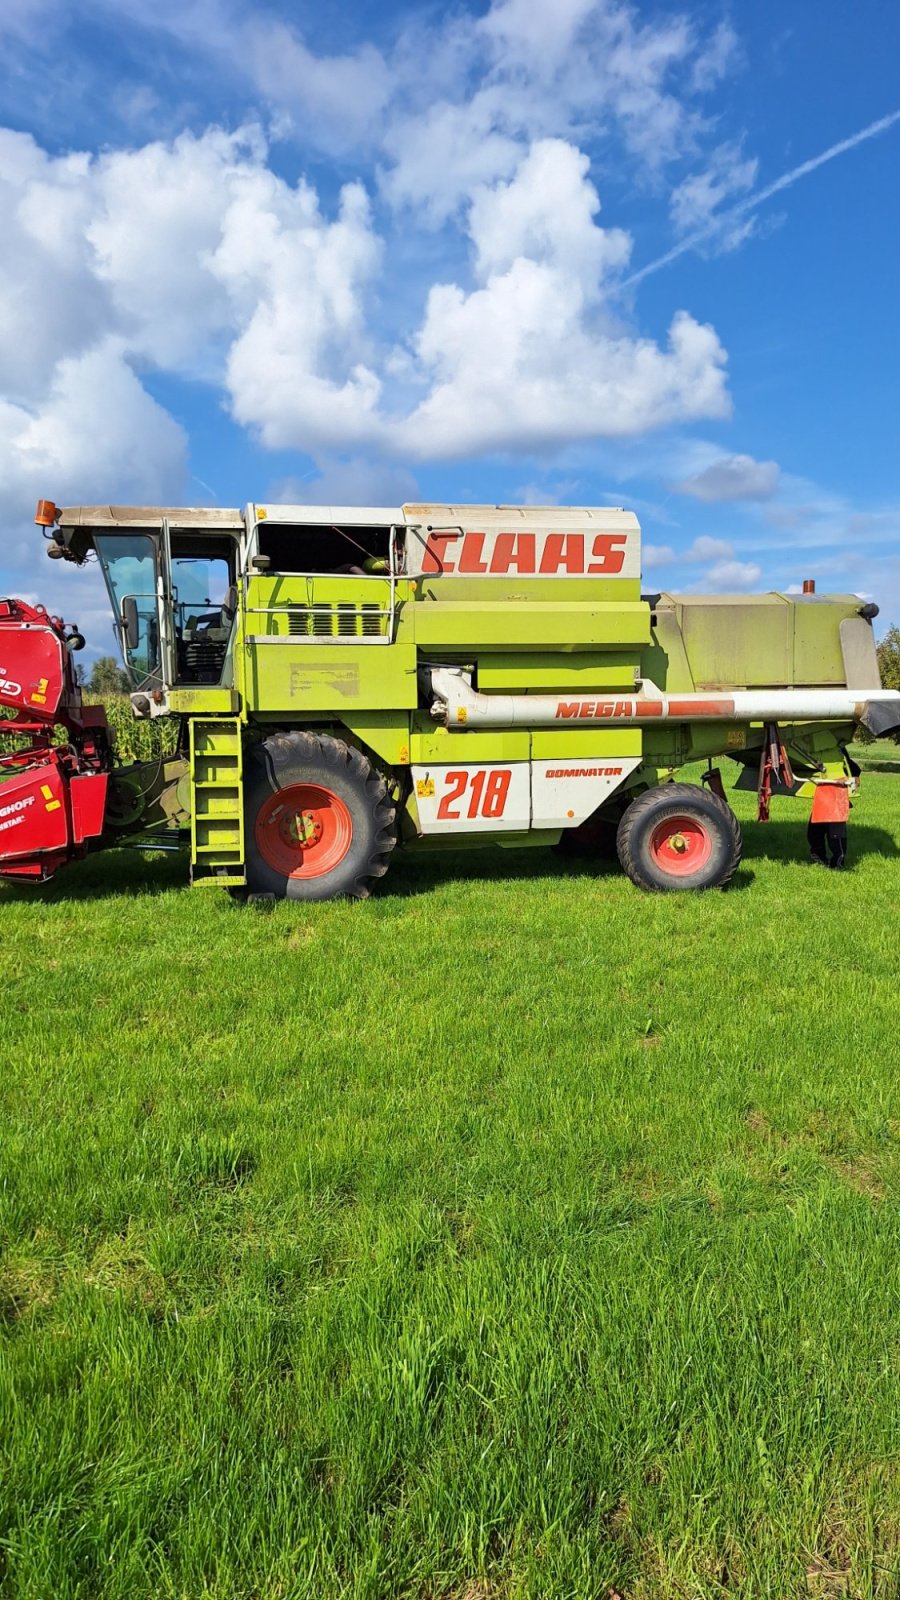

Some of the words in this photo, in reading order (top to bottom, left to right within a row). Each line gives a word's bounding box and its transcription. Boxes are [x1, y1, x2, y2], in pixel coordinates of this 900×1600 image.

[421, 532, 628, 574] CLAAS
[555, 701, 632, 718] MEGA
[545, 767, 623, 779] DOMINATOR
[436, 770, 512, 820] 218
